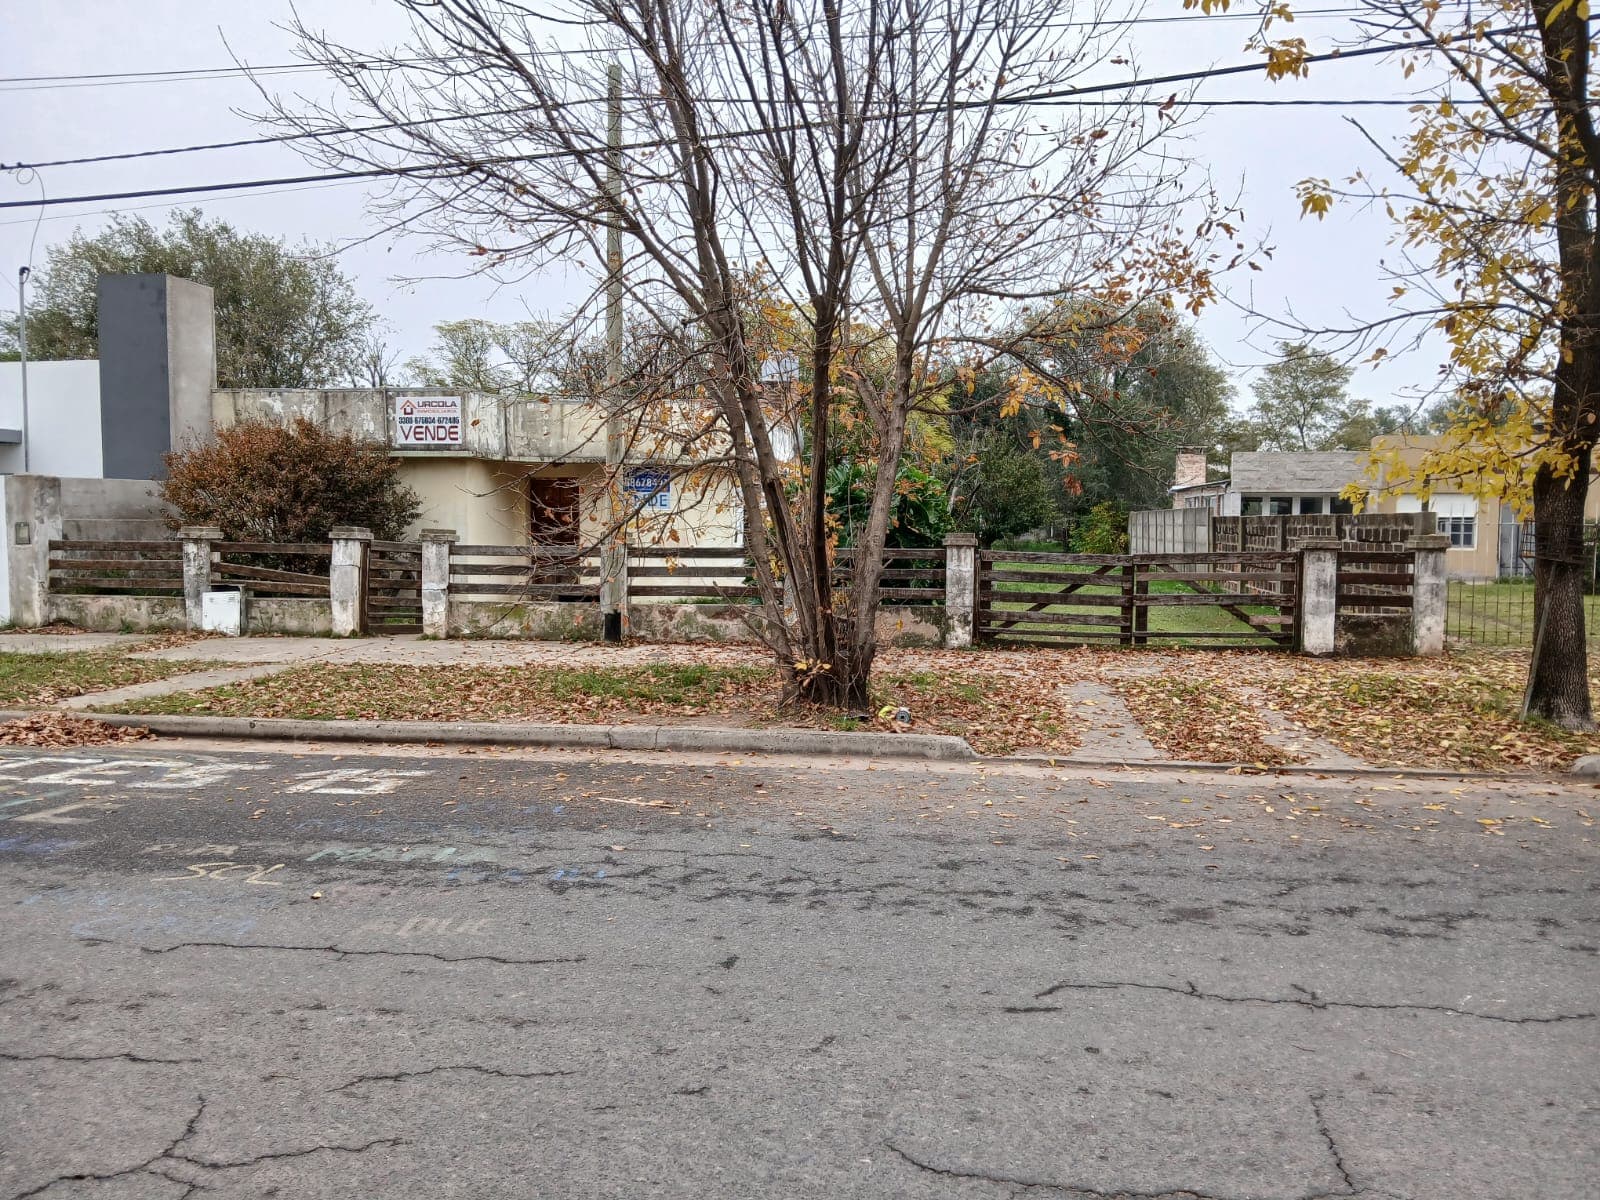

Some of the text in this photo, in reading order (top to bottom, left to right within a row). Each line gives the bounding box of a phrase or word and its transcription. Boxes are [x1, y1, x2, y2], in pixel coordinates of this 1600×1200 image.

[417, 400, 457, 408] URCOLA
[400, 425, 459, 441] VENDE
[150, 862, 286, 885] SOL
